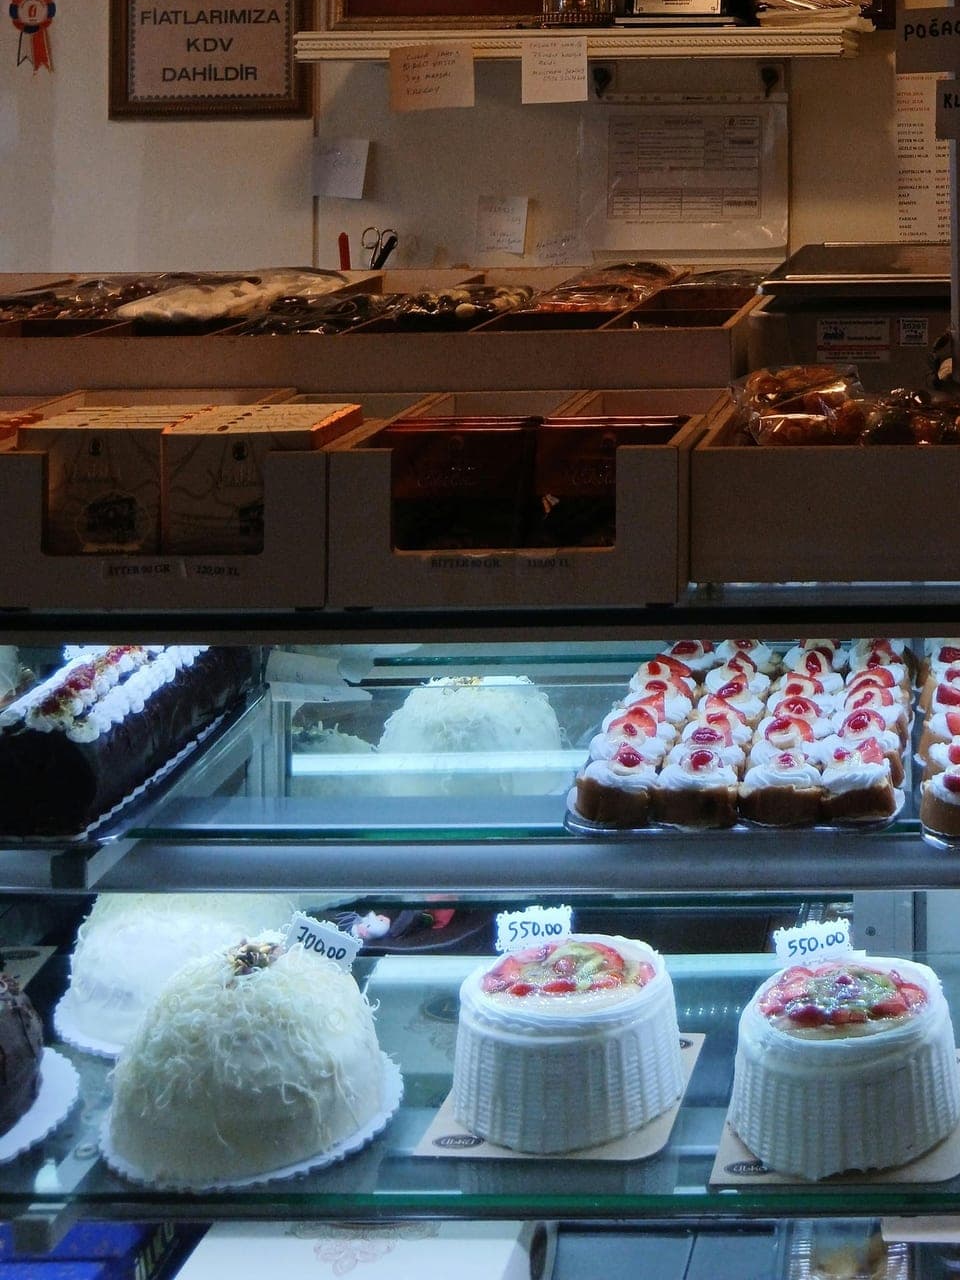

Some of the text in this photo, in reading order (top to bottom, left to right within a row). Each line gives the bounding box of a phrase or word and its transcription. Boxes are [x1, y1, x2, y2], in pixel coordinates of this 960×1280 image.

[140, 7, 281, 26] FİATLARIMIZA
[186, 37, 234, 53] KDV
[162, 63, 258, 82] DAHİLDİR
